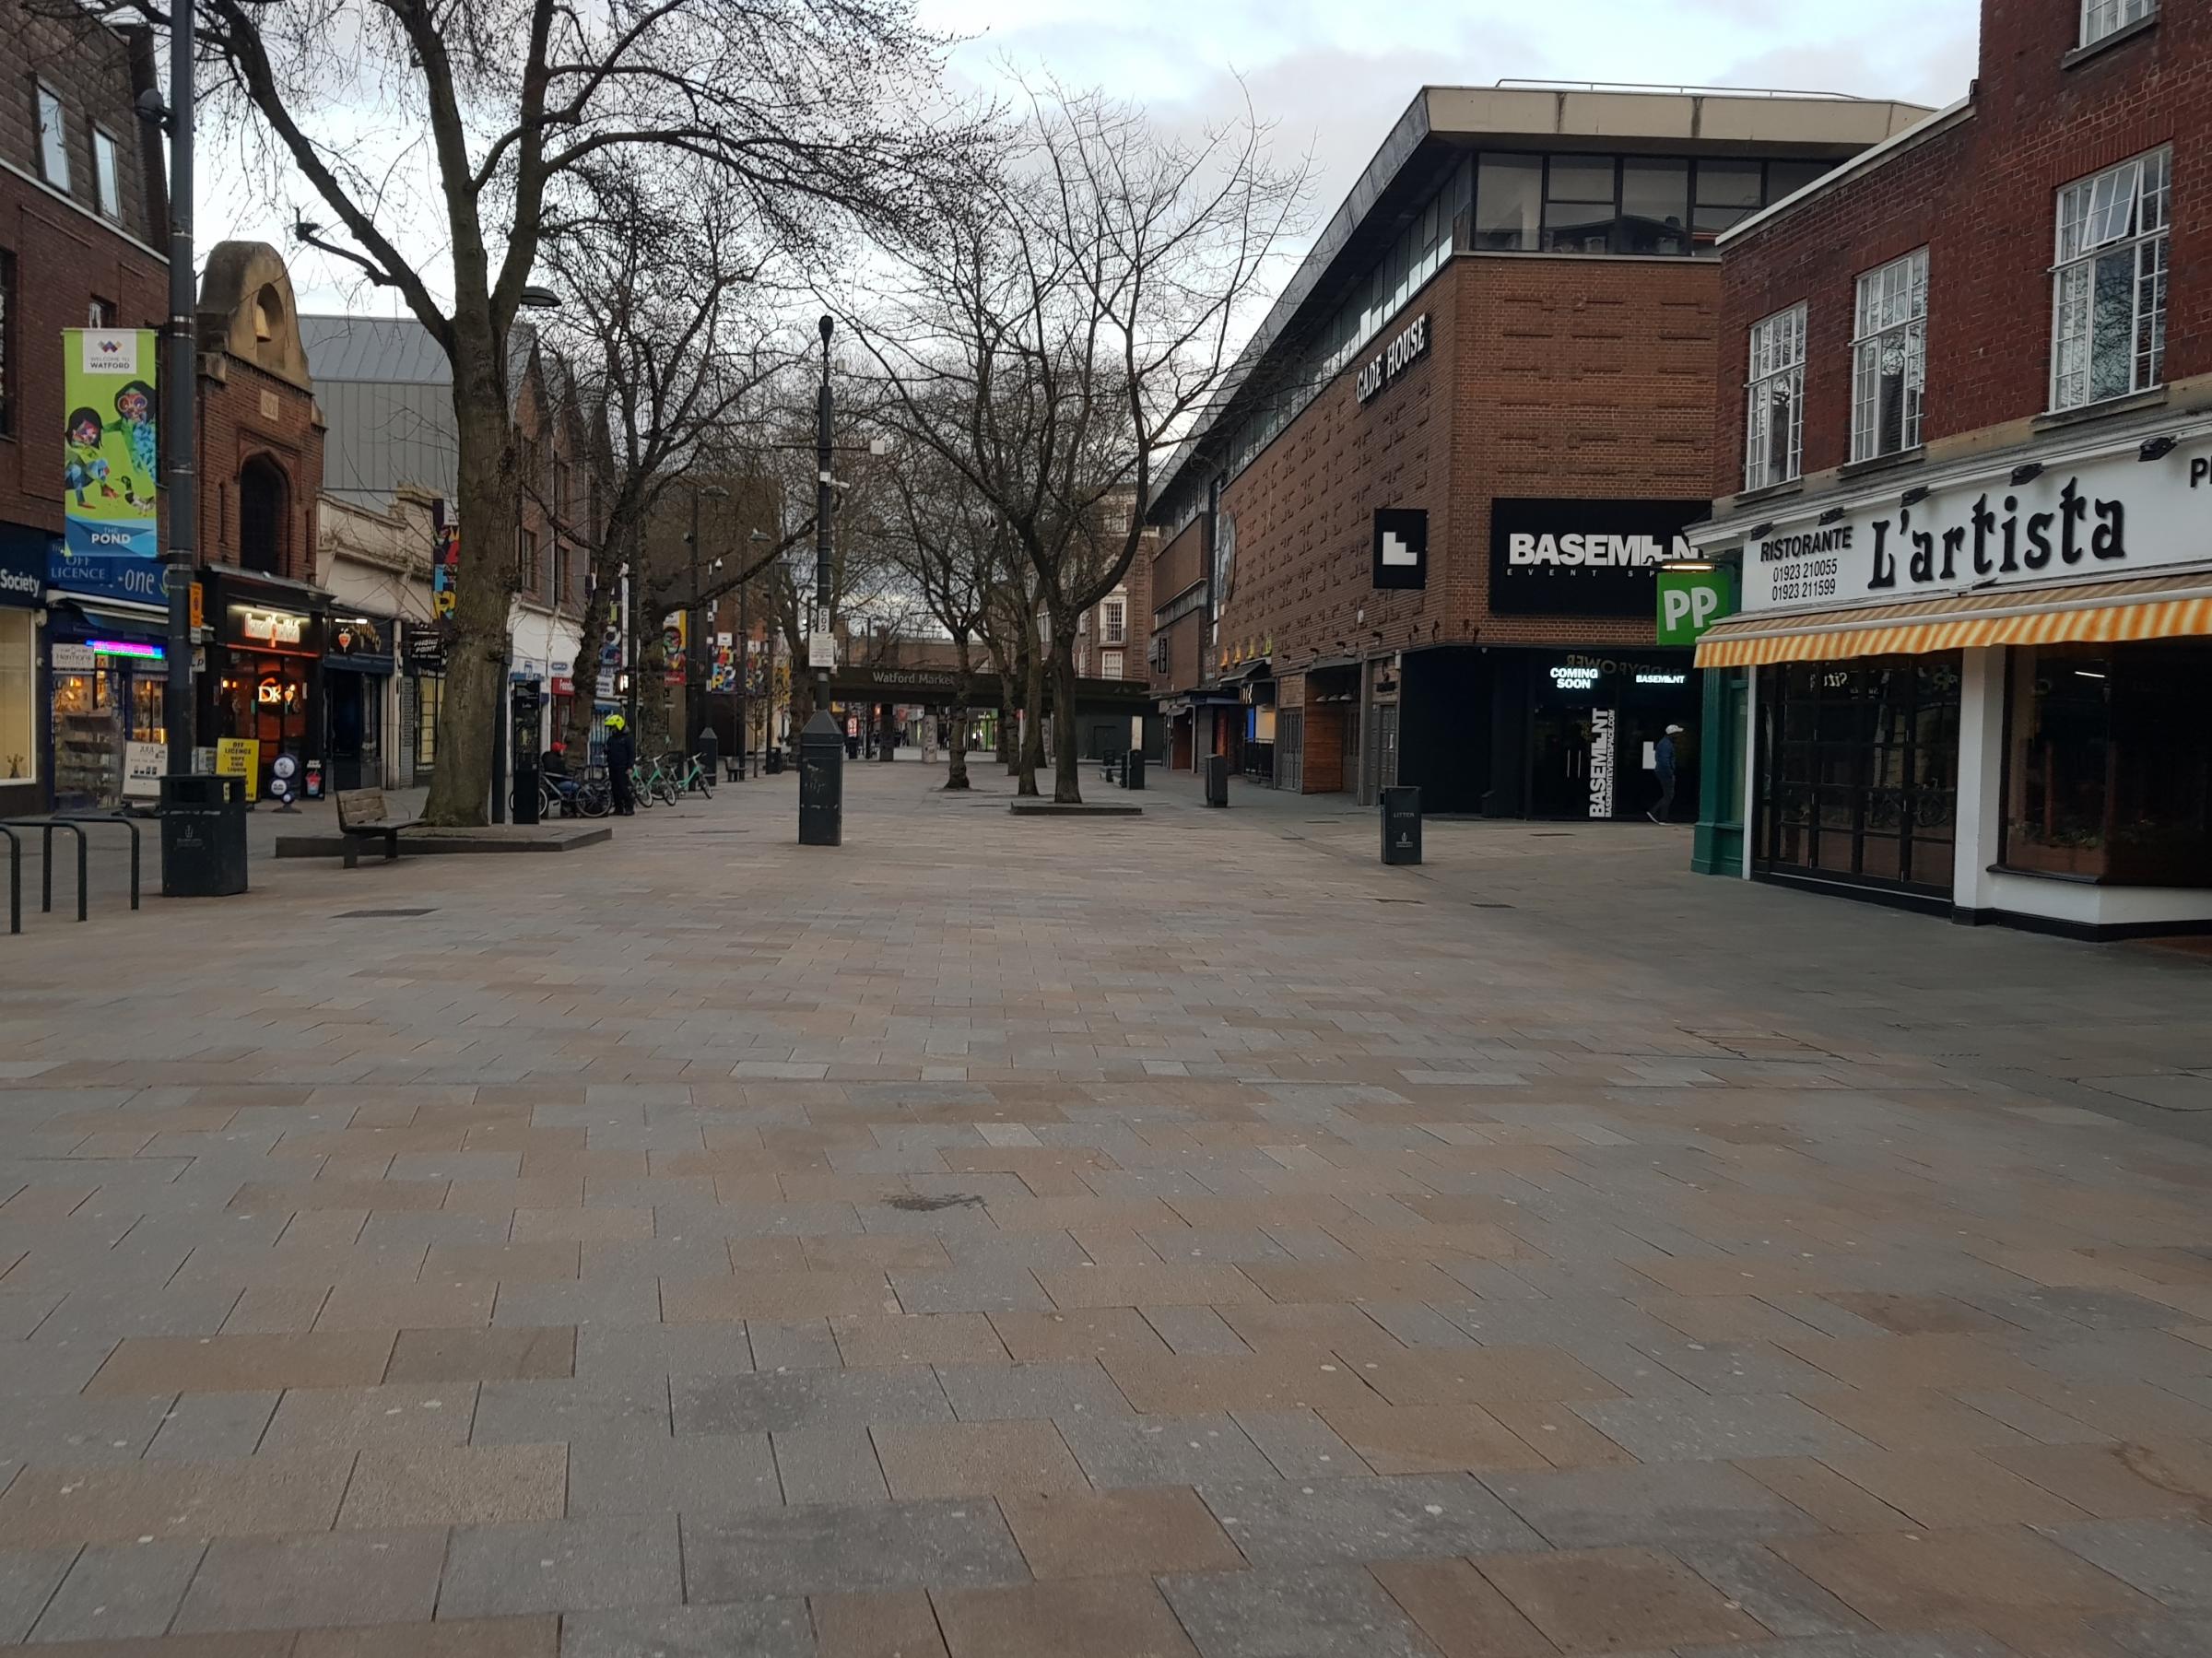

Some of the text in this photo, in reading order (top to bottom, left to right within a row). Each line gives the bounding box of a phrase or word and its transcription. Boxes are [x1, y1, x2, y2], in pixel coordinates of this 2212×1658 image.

[1356, 312, 1426, 404] GADE HOUSE
[92, 534, 131, 544] POND
[1760, 525, 1853, 562] RISTORANTE
[1867, 476, 2126, 590] L'artista
[52, 568, 105, 580] LICENCE
[124, 569, 155, 594] one
[1507, 569, 1597, 577] EVENT
[1773, 559, 1838, 582] 01923 210055
[0, 568, 40, 597] Society
[1772, 578, 1835, 601] 01923 211599
[1663, 586, 1718, 631] PP
[873, 671, 915, 684] Watford
[1549, 667, 1599, 679] COMING
[1556, 678, 1591, 689] SOON
[1635, 675, 1685, 684] BASEMENT
[1589, 707, 1608, 817] BASEMENT
